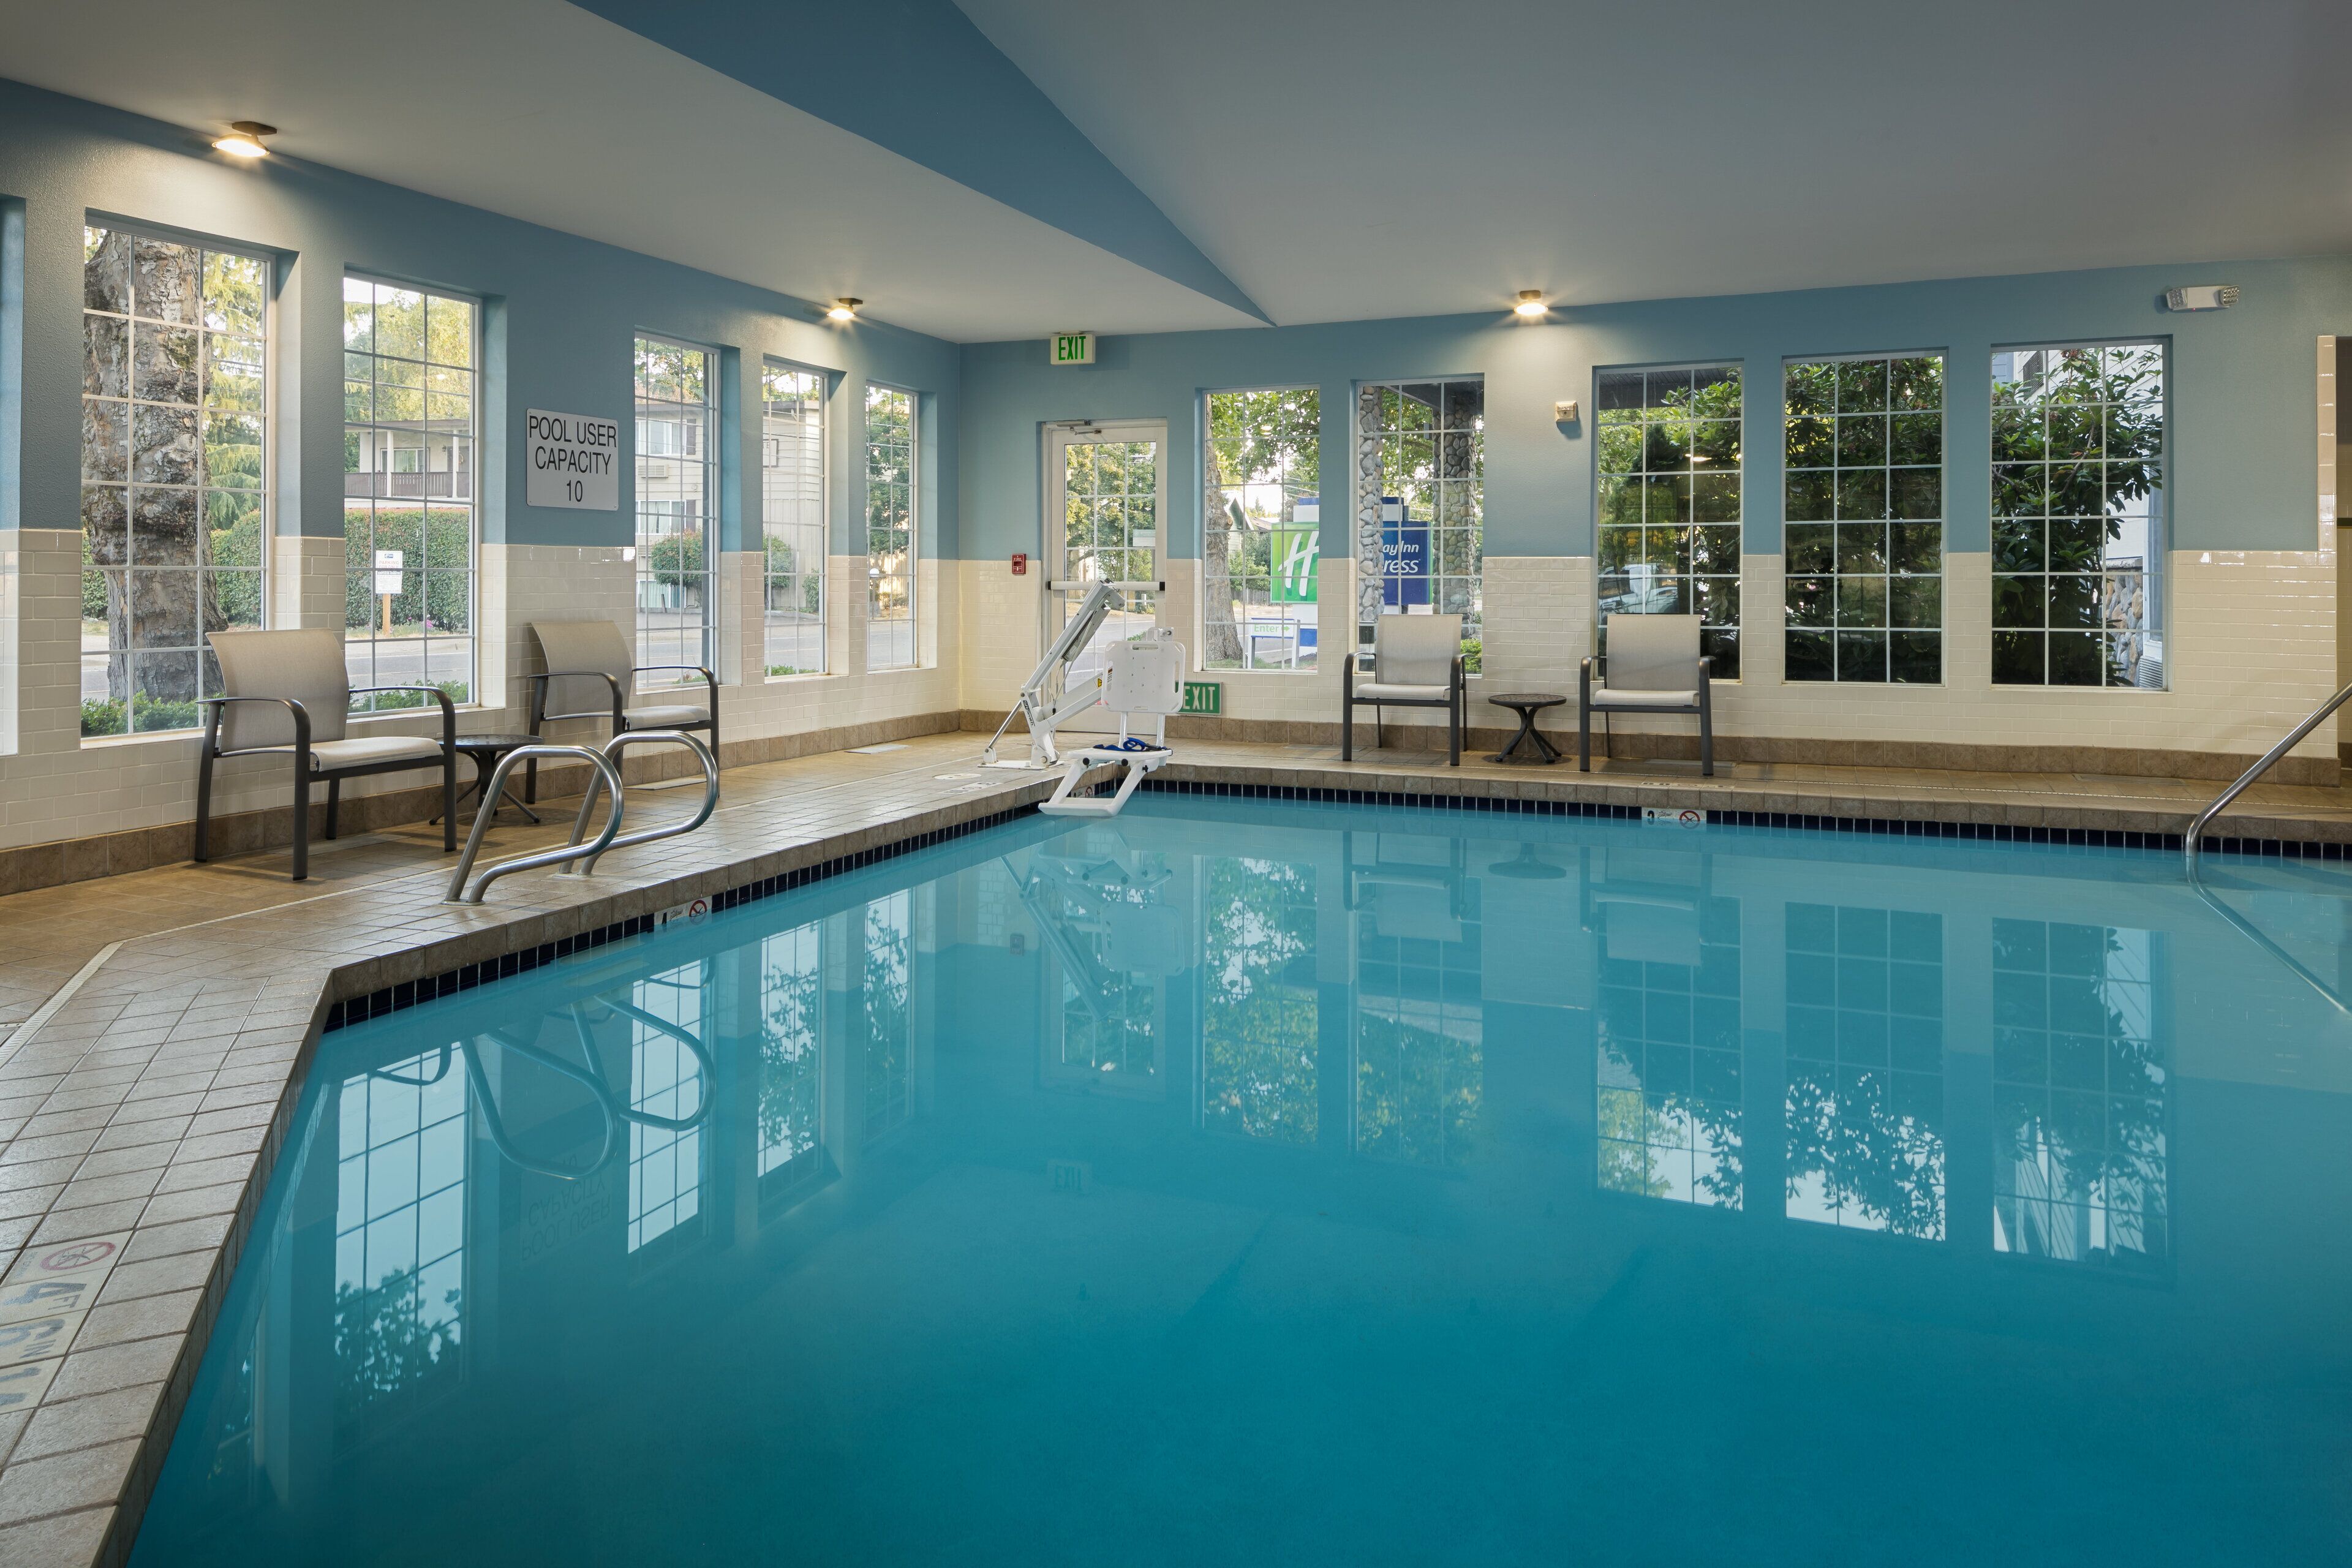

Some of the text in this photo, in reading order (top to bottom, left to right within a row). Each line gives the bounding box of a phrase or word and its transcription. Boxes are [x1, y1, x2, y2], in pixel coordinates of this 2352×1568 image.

[1058, 336, 1087, 361] EXIT
[529, 415, 617, 448] POOL USER
[535, 446, 611, 475] CAPACITY
[566, 480, 583, 502] 10
[1383, 560, 1419, 573] ress
[1254, 624, 1280, 633] Enter
[1183, 685, 1216, 710] EXIT
